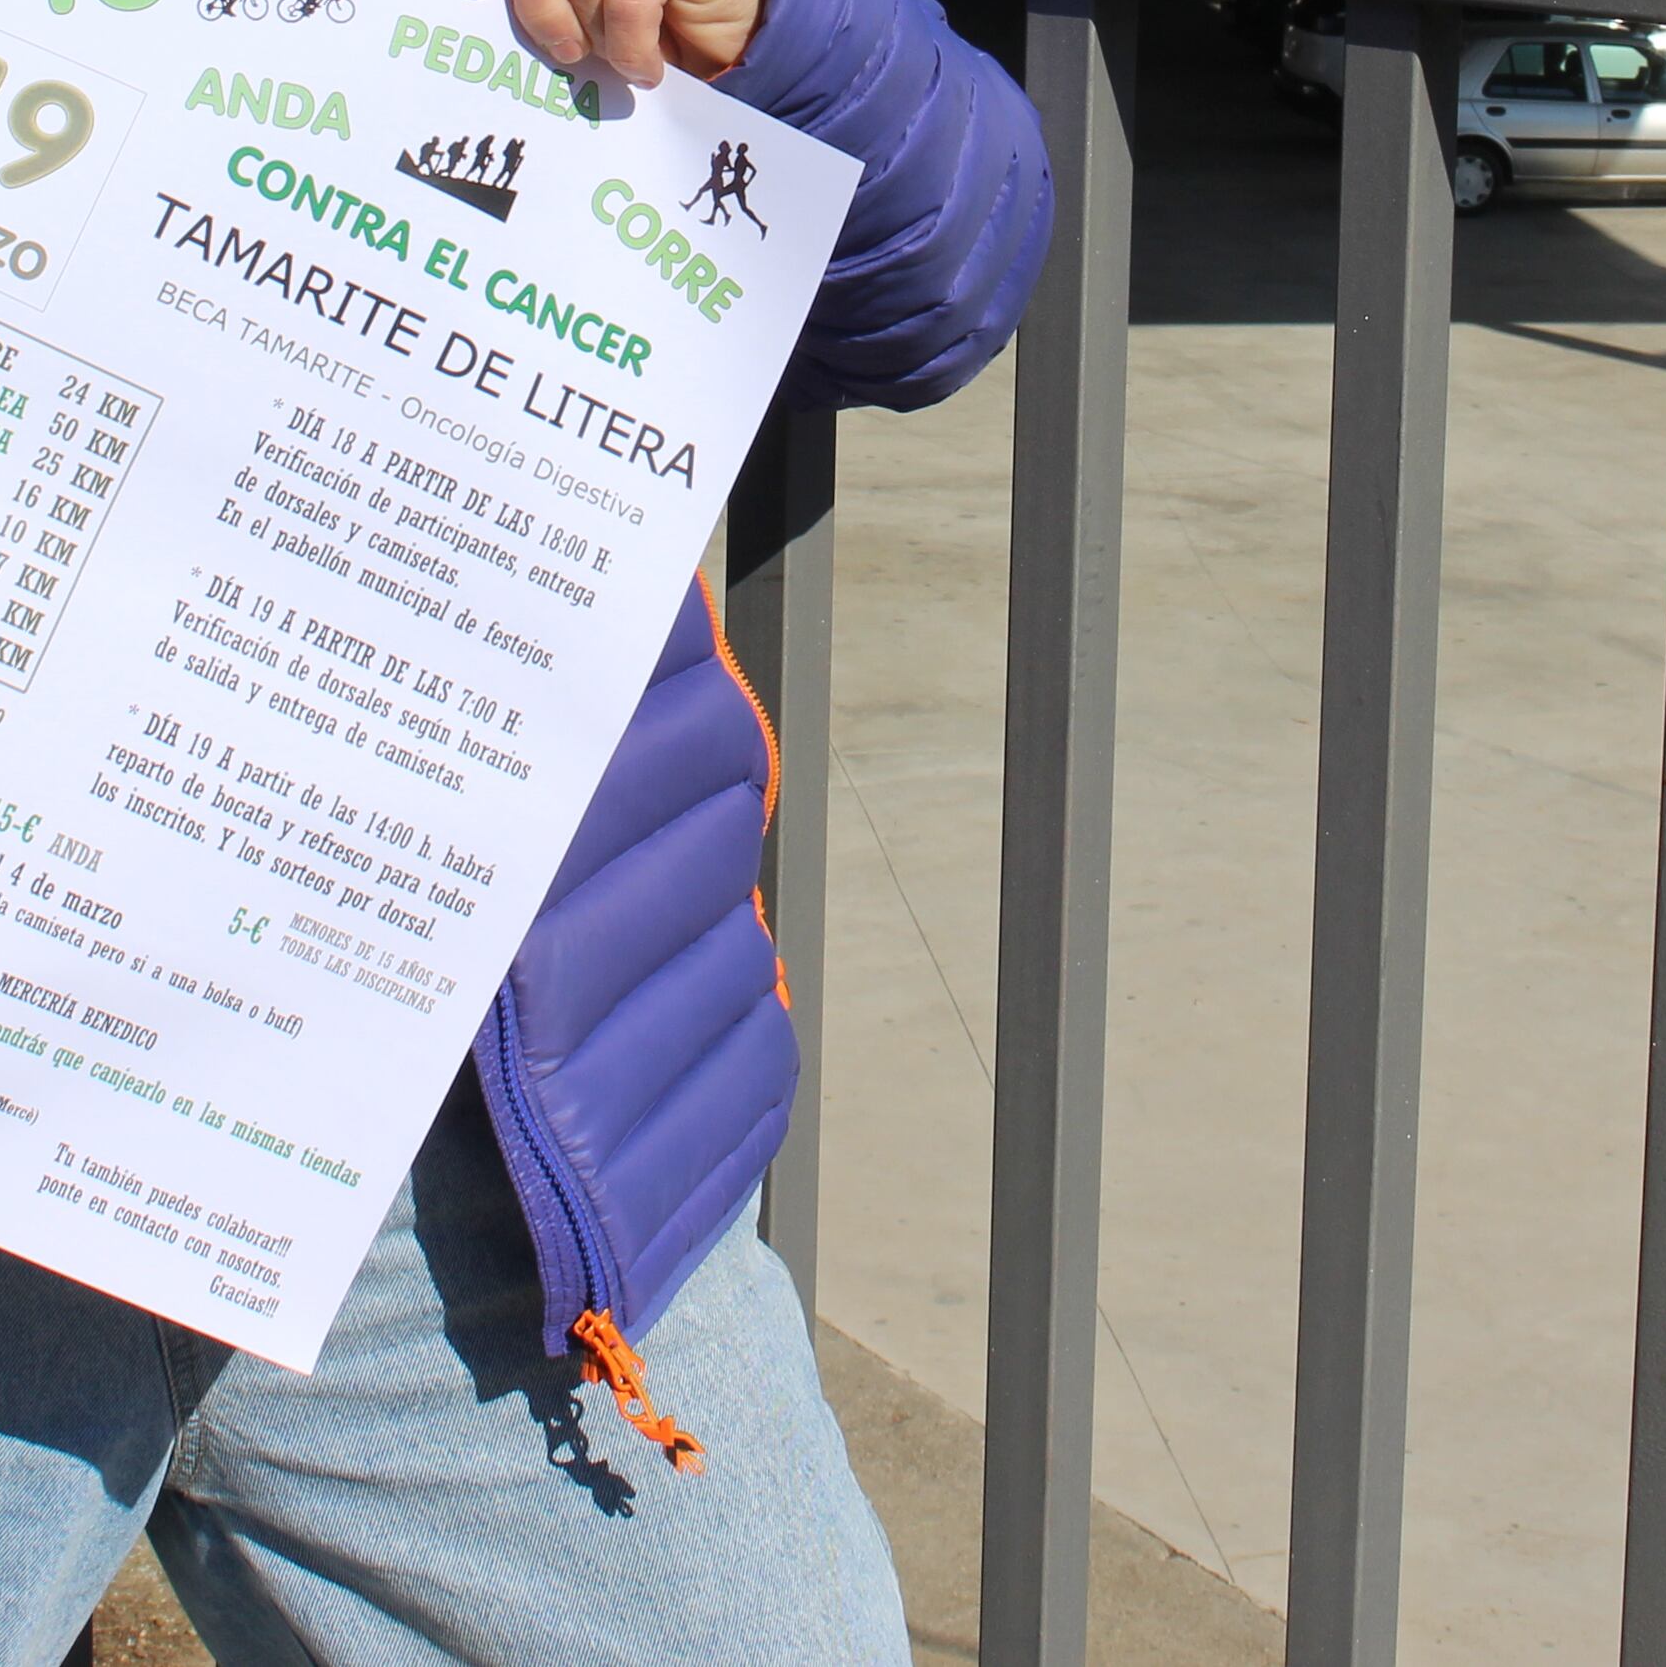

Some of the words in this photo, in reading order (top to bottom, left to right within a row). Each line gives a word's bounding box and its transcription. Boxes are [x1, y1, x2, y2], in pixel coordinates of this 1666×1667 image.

[185, 67, 351, 141] ANDA
[388, 15, 600, 129] PEDALEA
[226, 145, 411, 263] CONTRA
[422, 237, 470, 292] EL
[483, 268, 652, 378] CANCER
[591, 178, 743, 323] CORRE
[153, 191, 428, 358] TAMARITE
[433, 330, 515, 399] DE
[521, 371, 695, 490] LITERA
[156, 280, 227, 332] BECA
[239, 316, 375, 398] TAMARITE
[400, 396, 525, 470] Oncología
[532, 456, 644, 526] Digestiva
[253, 429, 362, 501] Verificación
[393, 504, 518, 578] participantes,
[527, 565, 596, 608] entrega
[263, 478, 342, 532] dorsales
[367, 531, 460, 589] camisetas.
[285, 405, 327, 442] DÍA
[330, 426, 357, 456] 18
[380, 449, 458, 504] PARTIR
[492, 501, 536, 538] LAS
[538, 523, 588, 562] 18:00
[204, 574, 245, 610] DÍA
[248, 594, 275, 623] 19
[299, 617, 376, 671] PARTIR
[411, 668, 454, 705] LAS
[456, 688, 498, 724] 7:00
[269, 529, 352, 578] pabellón
[356, 567, 452, 622] municipal
[481, 620, 554, 672] festejos.
[172, 598, 280, 670] Verificación
[316, 667, 393, 719] dorsales
[396, 709, 452, 746] según
[456, 729, 532, 781] horarios
[182, 653, 241, 692] salida
[268, 691, 338, 737] entrega
[374, 739, 464, 794] camisetas.
[46, 832, 103, 873] ANDA
[88, 771, 120, 803] los
[123, 786, 206, 844] inscritos.
[235, 835, 266, 867] los
[268, 856, 336, 897] sorteos
[335, 885, 374, 913] por
[376, 898, 437, 942] dorsal.
[105, 743, 175, 787] reparto
[209, 783, 273, 831] bocata
[297, 828, 373, 874] refresco
[374, 863, 421, 895] para
[426, 881, 476, 918] todos
[141, 711, 182, 748] DÍA
[186, 732, 213, 761] 19
[235, 760, 296, 798] partir
[327, 794, 359, 826] las
[363, 811, 414, 850] 14:00
[440, 844, 496, 887] habrá
[14, 907, 85, 949] camiseta
[87, 939, 126, 965] pero
[168, 971, 198, 995] una
[201, 980, 243, 1013] bolsa
[262, 1005, 304, 1040] buff)
[60, 890, 123, 931] marzo
[227, 906, 271, 946] 5-€
[279, 934, 323, 965] TODAS
[323, 953, 352, 978] LAS
[352, 966, 436, 1015] DISCIPLINAS
[288, 912, 353, 951] MENORES
[394, 959, 434, 987] AÑOS
[77, 1005, 158, 1052] BENEDICO
[51, 1047, 84, 1071] que
[89, 1061, 167, 1105] canjearlo
[197, 1101, 226, 1130] las
[229, 1120, 295, 1160] mismas
[299, 1147, 361, 1189] tiendas
[36, 1174, 83, 1205] ponte
[113, 1205, 179, 1245] contacto
[183, 1235, 212, 1259] con
[215, 1248, 281, 1289] nosotros.
[77, 1156, 143, 1197] también
[144, 1186, 203, 1223] puedes
[205, 1211, 293, 1258] colaborar!!!
[209, 1274, 280, 1318] Gracias!!!
